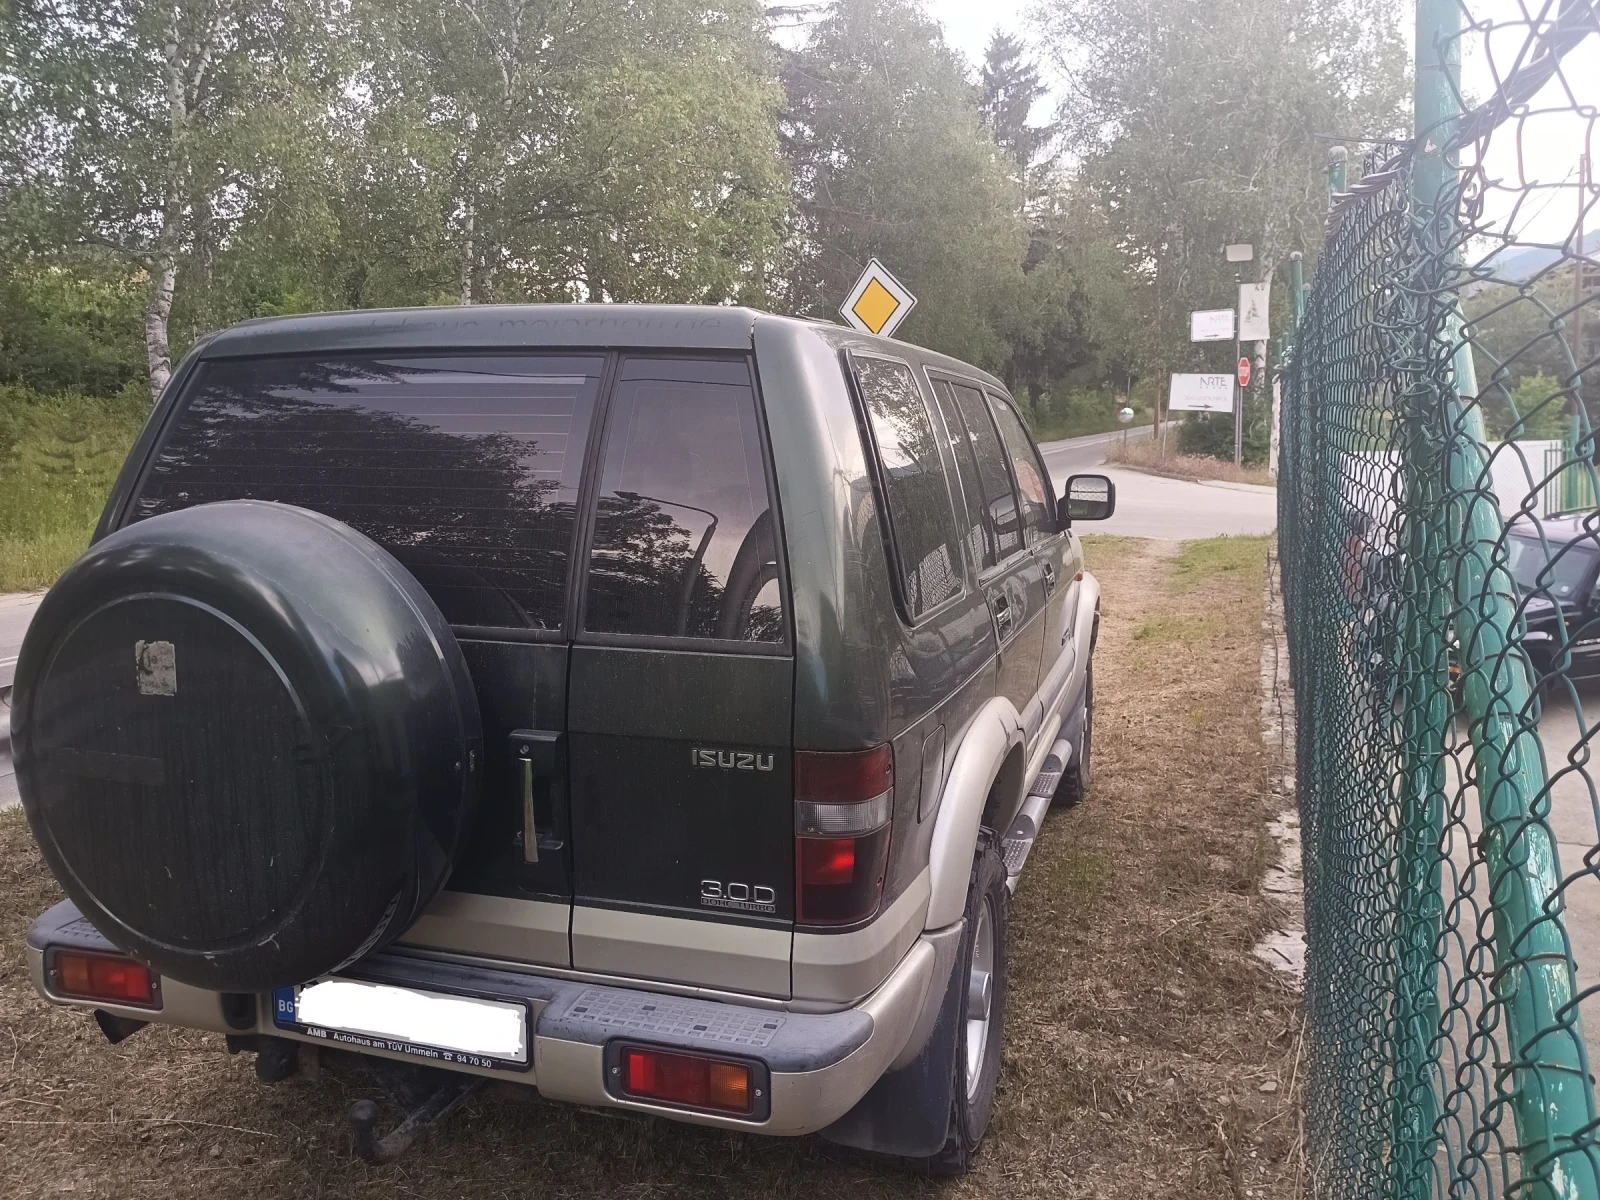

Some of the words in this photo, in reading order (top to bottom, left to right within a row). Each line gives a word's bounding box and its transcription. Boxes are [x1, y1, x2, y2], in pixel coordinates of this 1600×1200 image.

[692, 749, 774, 771] ISUZU
[701, 897, 731, 907] DOHC
[736, 902, 775, 913] TURBO
[278, 999, 294, 1013] BG
[307, 1027, 327, 1038] AMB
[333, 1032, 371, 1046] Autohaus
[373, 1040, 386, 1049] am
[387, 1041, 403, 1052] TÜV
[404, 1045, 439, 1059] Ummeln
[456, 1054, 467, 1064] 94
[469, 1056, 480, 1066] 70
[481, 1059, 492, 1068] 50
